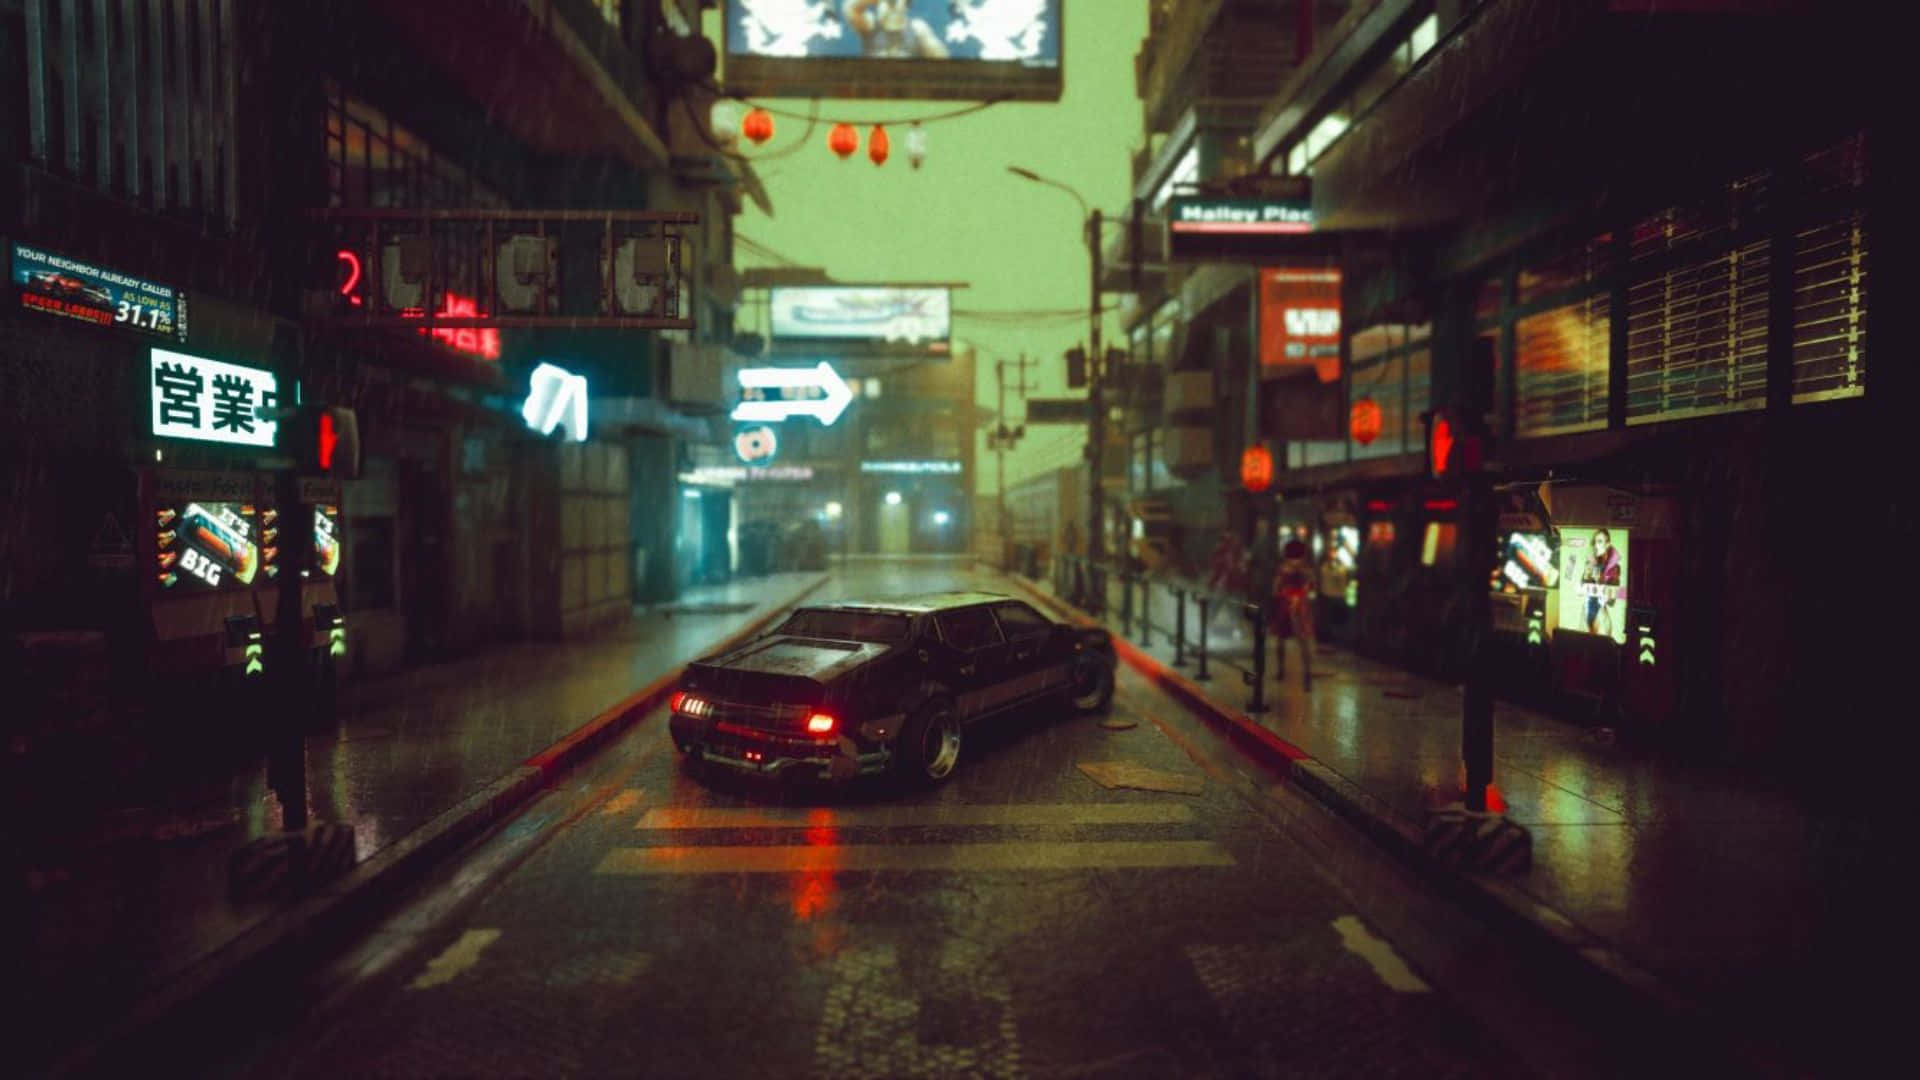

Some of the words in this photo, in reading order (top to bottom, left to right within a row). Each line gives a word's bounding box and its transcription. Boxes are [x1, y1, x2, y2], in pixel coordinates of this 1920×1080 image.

[16, 246, 47, 264] YOUR
[48, 256, 100, 278] NEIGHBOR
[100, 271, 140, 289] ALREADY
[141, 282, 172, 297] CALLED
[138, 294, 158, 306] LOW
[179, 547, 223, 587] BIG
